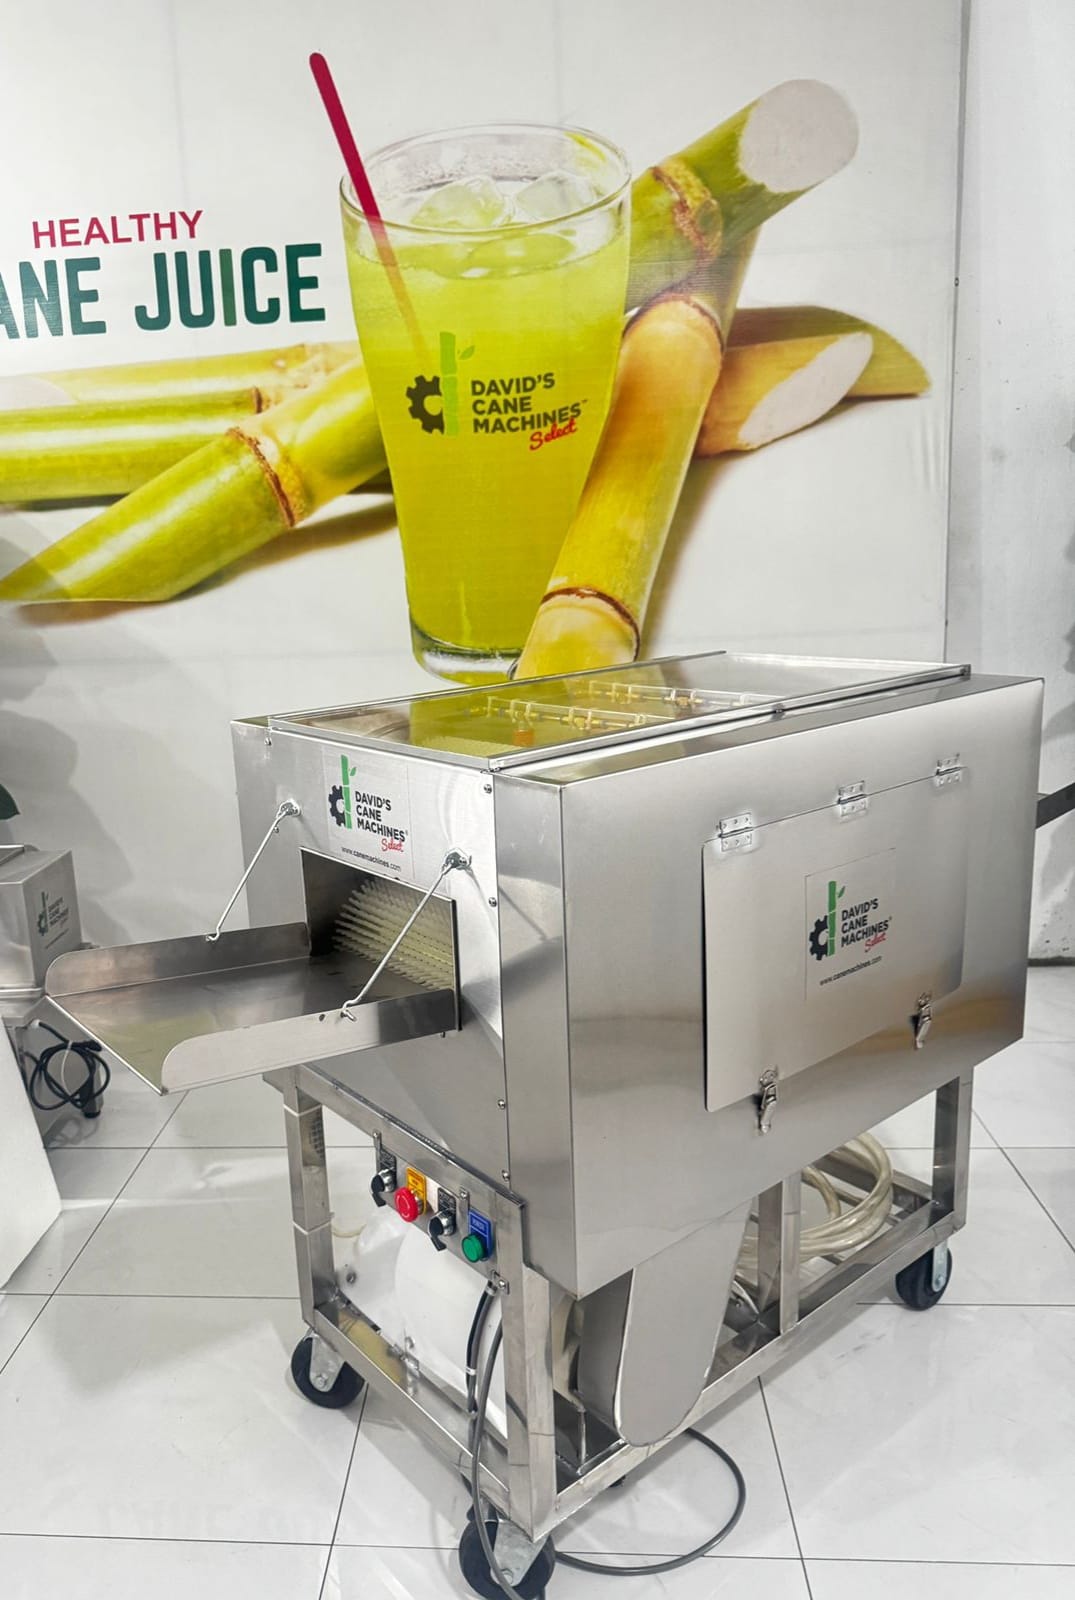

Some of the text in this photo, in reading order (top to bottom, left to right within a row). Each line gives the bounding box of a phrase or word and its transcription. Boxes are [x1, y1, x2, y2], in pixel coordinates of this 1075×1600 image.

[32, 210, 203, 249] HEALTHY
[134, 243, 326, 331] JUICE
[471, 372, 555, 396] DAVID'S
[472, 396, 532, 416] CANE
[473, 402, 582, 433] MACHINES
[530, 417, 577, 451] Select
[355, 790, 392, 812] DAVID'S
[356, 805, 382, 822] CANE
[357, 818, 406, 842] MACHINES
[381, 837, 404, 853] Select
[841, 898, 878, 921] DAVID'S
[841, 915, 868, 934] CANE
[841, 919, 889, 948] MACHINES
